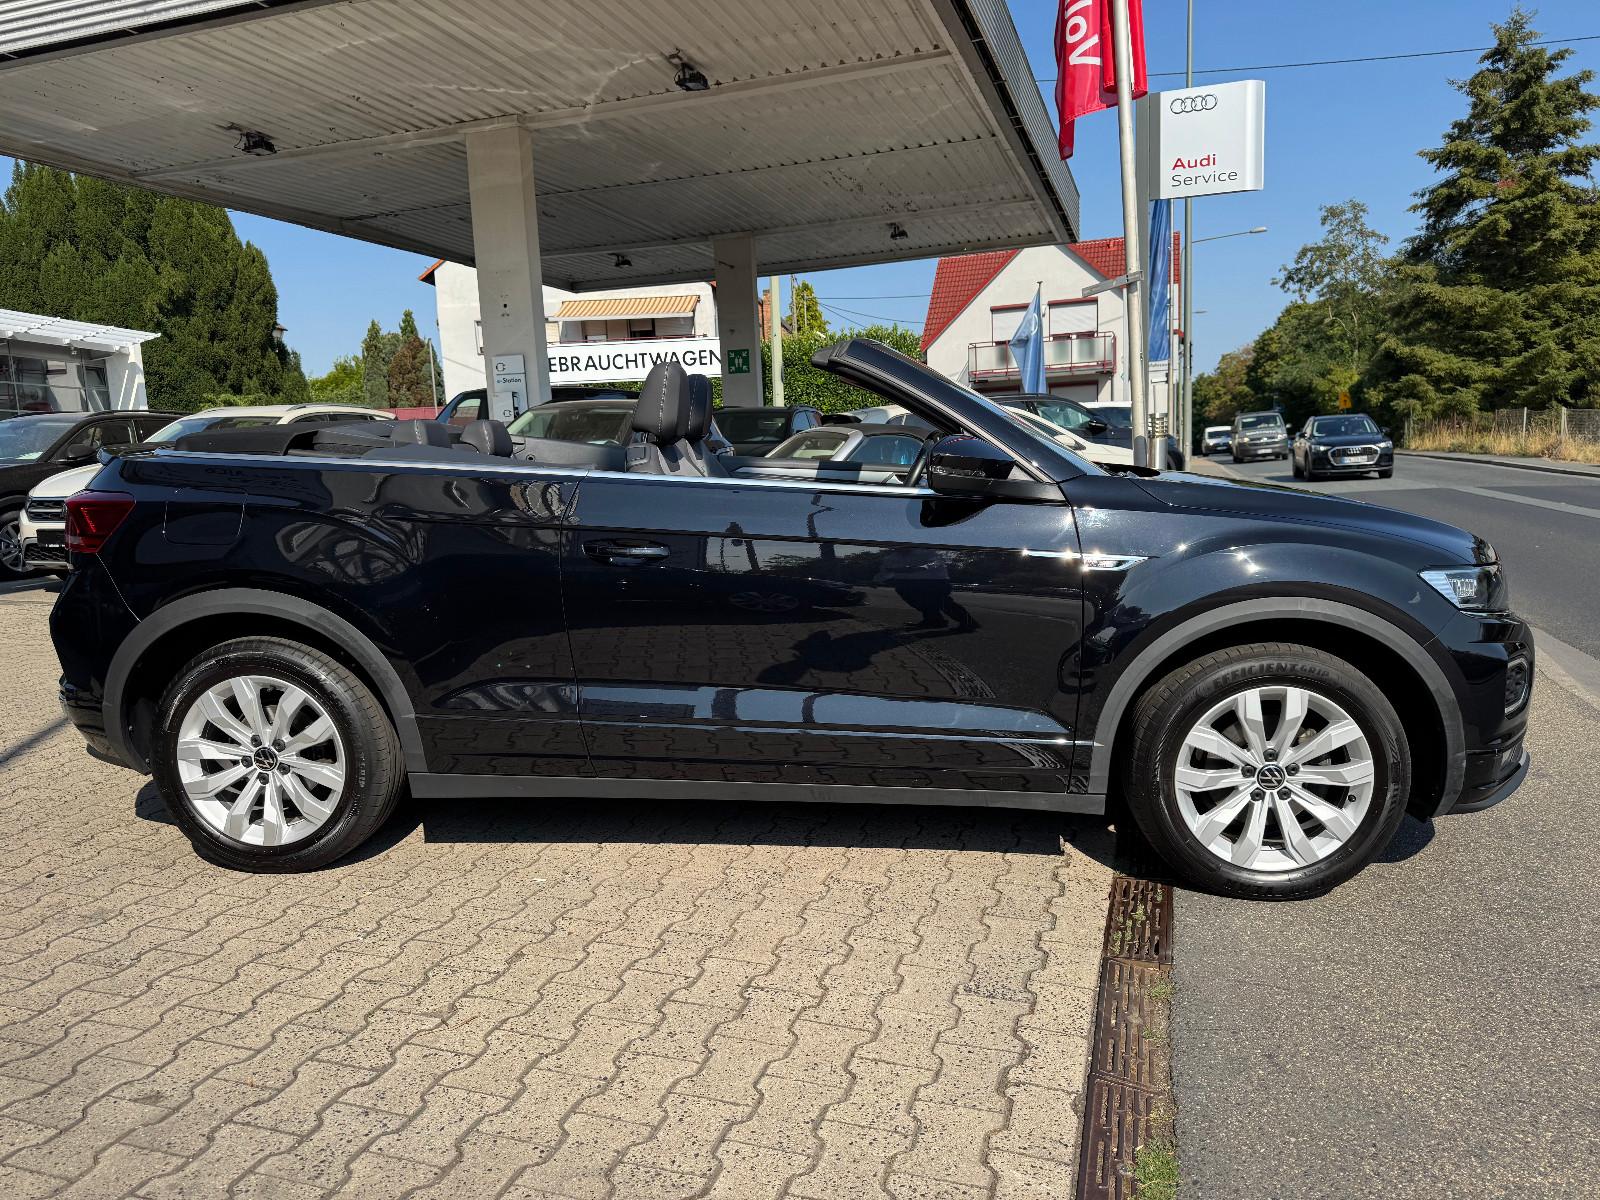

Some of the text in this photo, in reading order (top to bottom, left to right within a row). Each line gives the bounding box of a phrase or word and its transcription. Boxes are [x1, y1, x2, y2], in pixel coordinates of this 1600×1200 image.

[1065, 0, 1101, 65] Vol
[1172, 154, 1217, 170] Audi
[1171, 170, 1238, 187] Service
[548, 350, 722, 373] EBRAUCHTWAGEN
